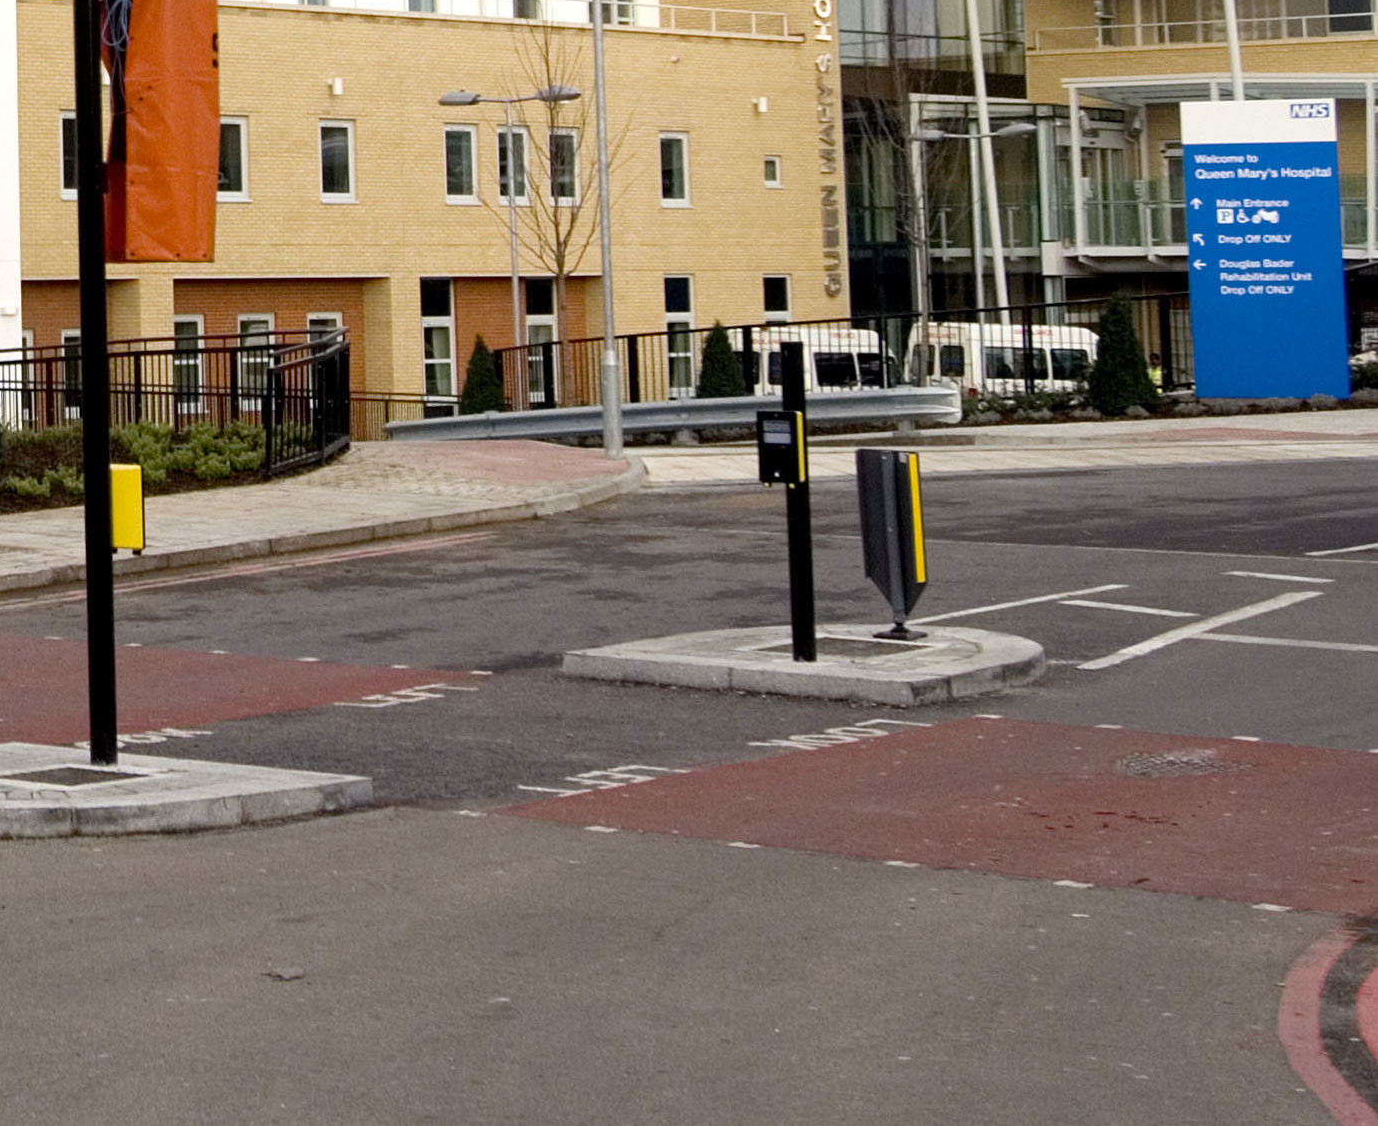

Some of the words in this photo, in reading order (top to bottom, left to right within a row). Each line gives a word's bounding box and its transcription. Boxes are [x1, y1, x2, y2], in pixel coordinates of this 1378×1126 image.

[1291, 104, 1328, 117] NHS
[1194, 154, 1244, 163] Welcome
[1247, 154, 1258, 163] to
[1195, 169, 1235, 179] Queen
[1237, 168, 1278, 180] Mary's
[1281, 167, 1332, 179] Hospital
[1216, 199, 1241, 207] Main
[1243, 199, 1289, 207] Entrance
[821, 185, 842, 298] QUEEN
[1218, 235, 1243, 245] Drop
[1245, 234, 1261, 243] Off
[1263, 234, 1292, 243] ONLY
[1219, 259, 1261, 269] Douglas
[1263, 259, 1294, 268] Bader
[1220, 272, 1289, 281] Rehabilitation
[1291, 272, 1312, 281] Unit
[1221, 286, 1246, 296] Drop
[1248, 285, 1264, 294] Off
[1265, 285, 1294, 294] ONLY
[747, 719, 932, 750] LOOK
[518, 765, 690, 797] LEFT
